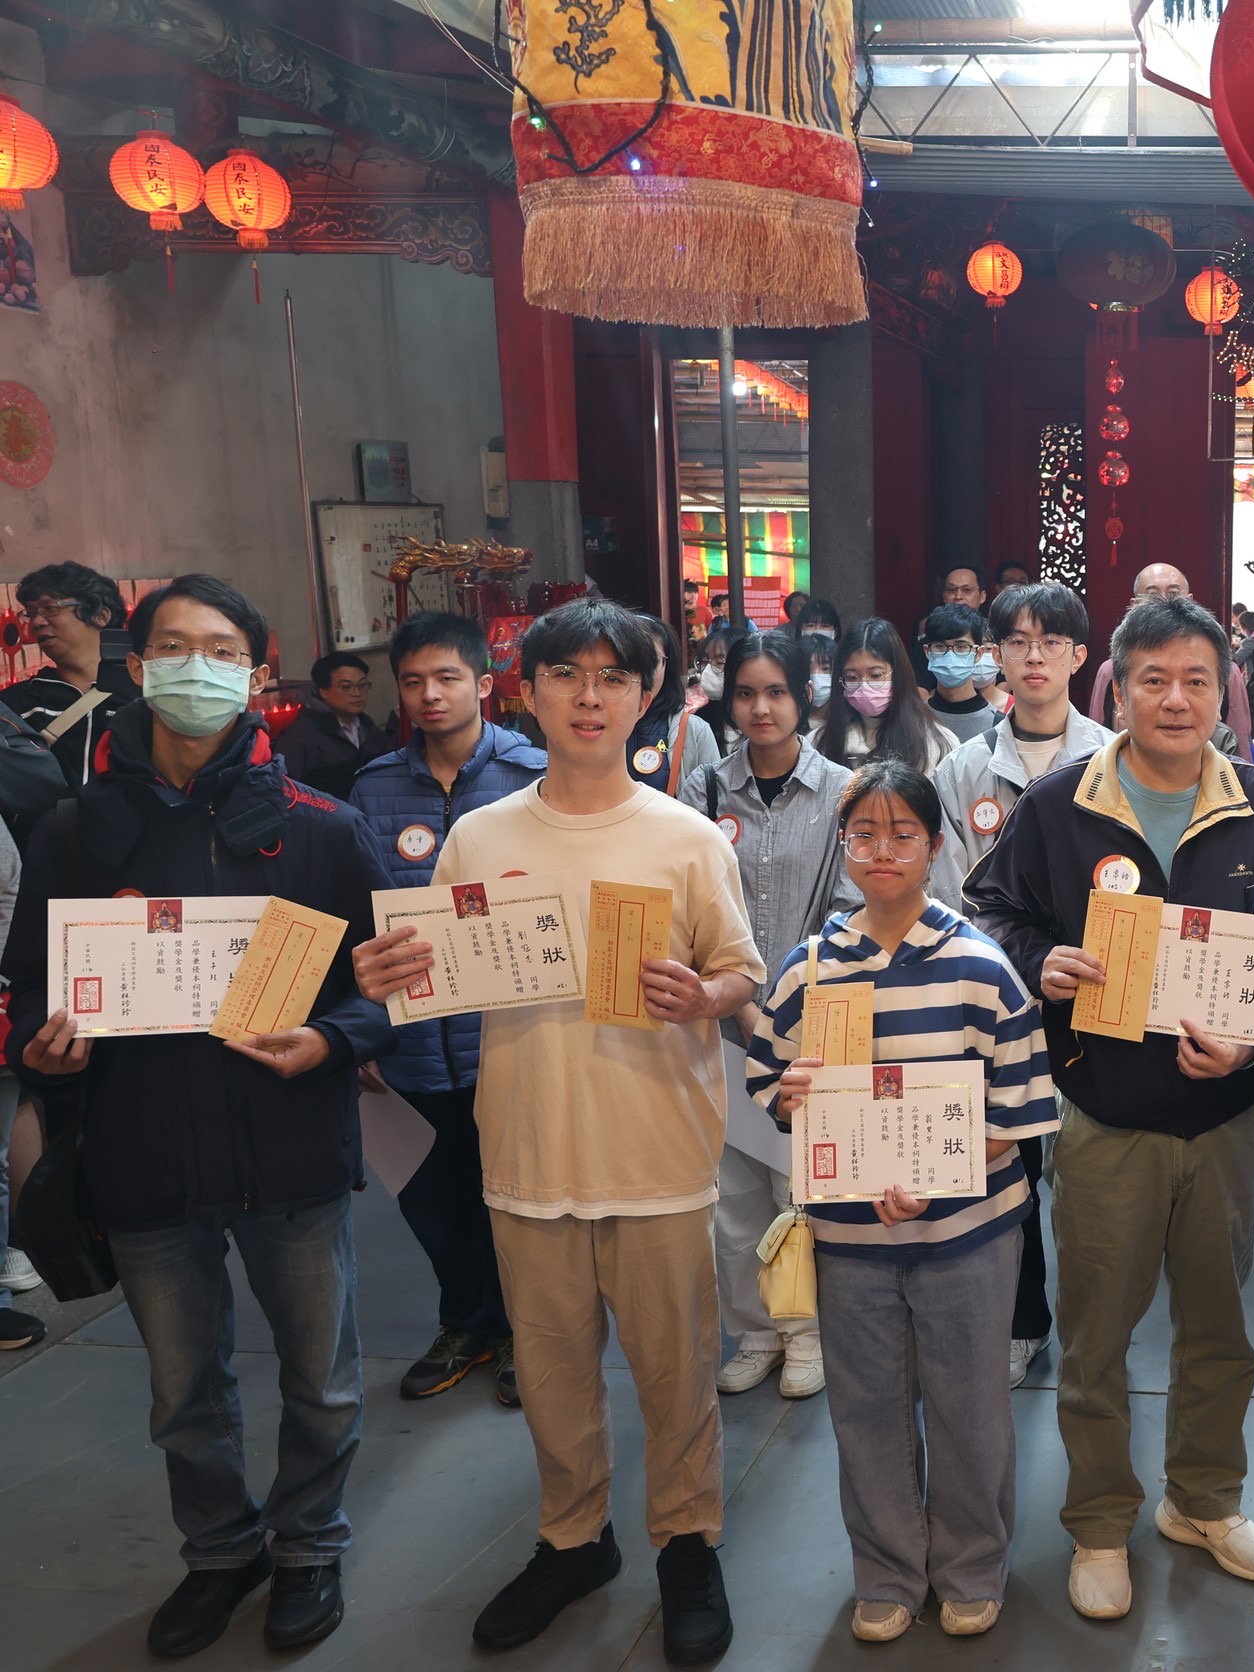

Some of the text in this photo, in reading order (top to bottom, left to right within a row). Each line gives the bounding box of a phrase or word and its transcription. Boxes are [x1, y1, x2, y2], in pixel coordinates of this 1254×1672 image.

[144, 143, 168, 196] 國泰民安
[232, 162, 255, 216] 國泰民安
[1000, 257, 1010, 291] 文昌祠
[156, 942, 166, 975] 以資鼓勵
[469, 926, 483, 957] 以資鼓勵
[485, 922, 503, 971] 獎學金及獎狀
[536, 913, 567, 964] 獎狀
[174, 940, 184, 991] 獎學金及獎狀
[1183, 949, 1193, 981] 以資鼓勵
[1195, 950, 1207, 998] 獎學金及獎狀
[881, 1108, 890, 1141] 以資鼓勵
[896, 1106, 905, 1158] 獎學金及獎狀
[943, 1103, 965, 1155] 獎狀
